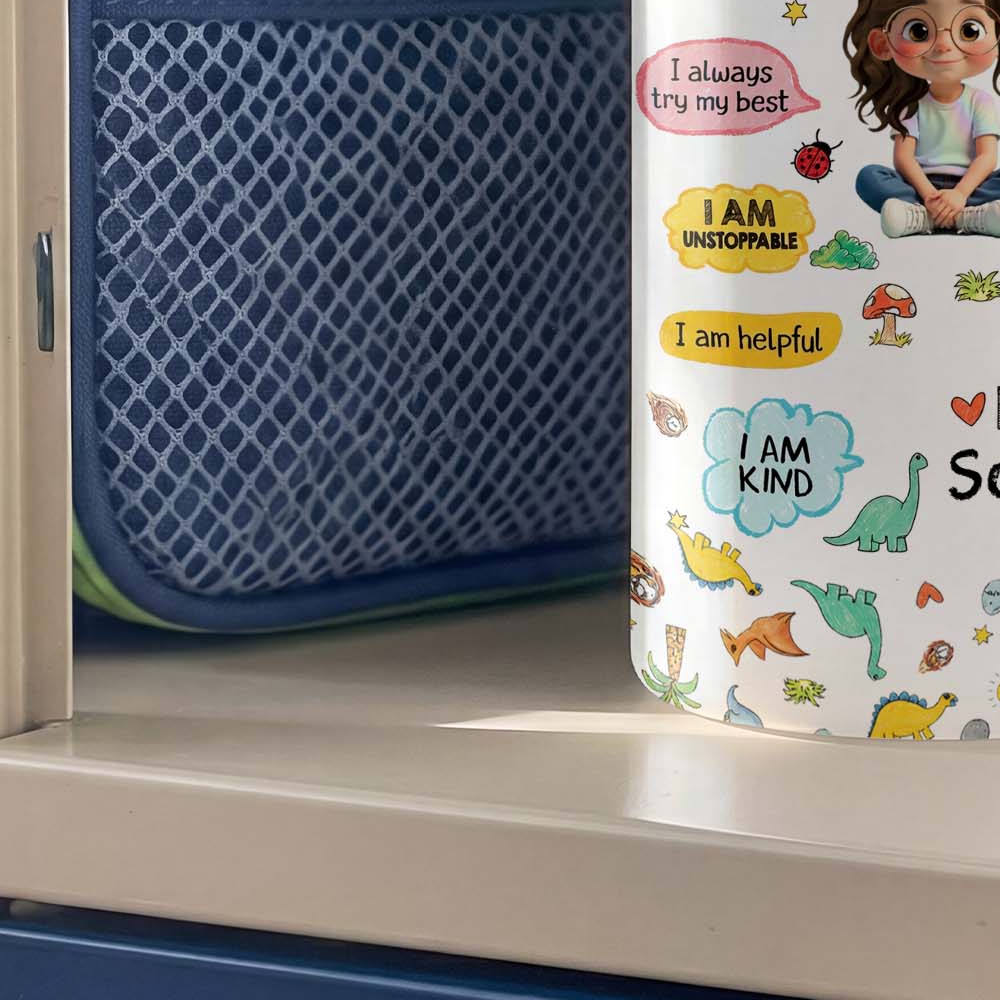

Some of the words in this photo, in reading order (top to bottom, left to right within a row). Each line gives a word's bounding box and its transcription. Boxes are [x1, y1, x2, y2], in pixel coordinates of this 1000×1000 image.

[670, 58, 681, 83] I
[689, 60, 773, 88] always
[651, 90, 688, 113] try
[697, 95, 728, 115] my
[736, 90, 789, 113] best
[703, 199, 713, 226] I
[722, 199, 775, 227] AM
[682, 230, 798, 250] UNSTOPPABLE
[674, 321, 686, 347] I
[695, 330, 729, 349] am
[739, 322, 822, 356] helpful
[740, 432, 749, 461] I
[759, 436, 809, 465] AM
[739, 465, 813, 497] KIND
